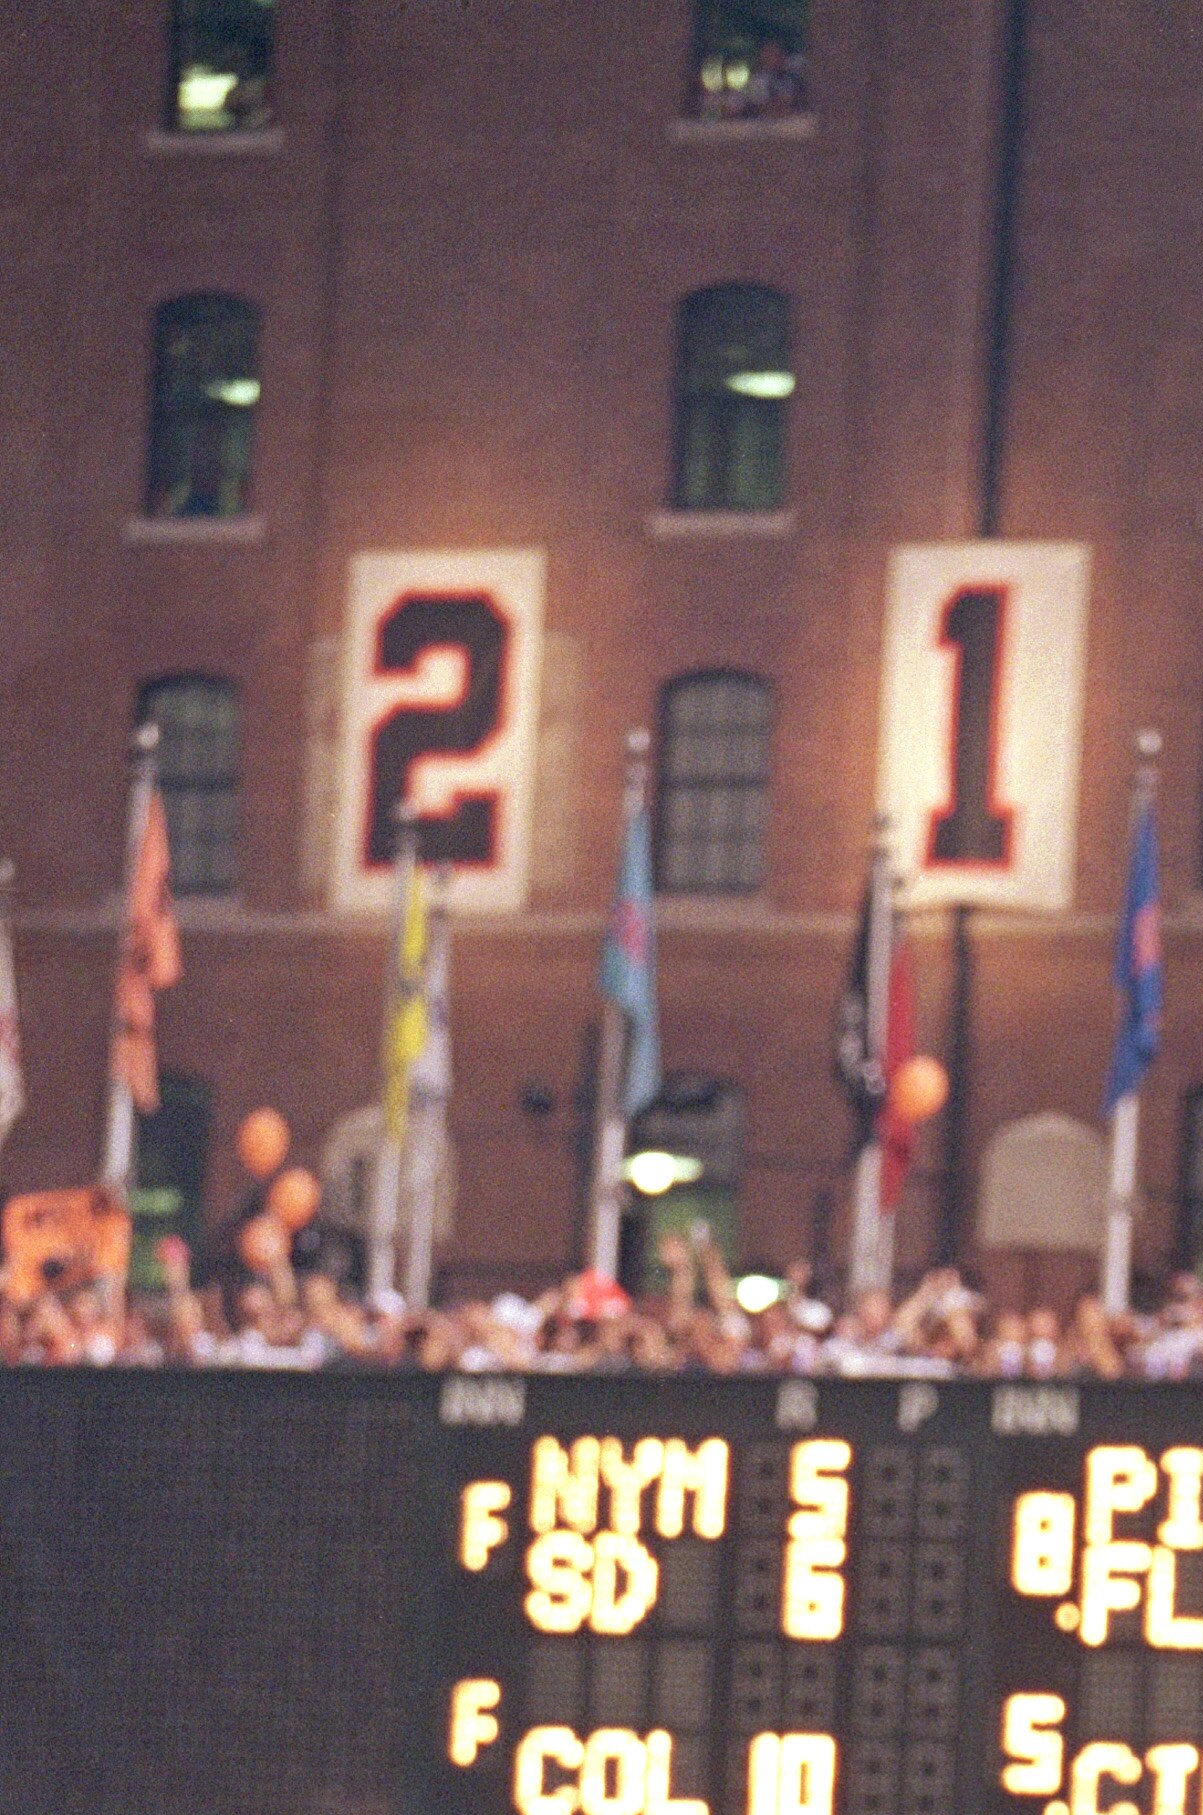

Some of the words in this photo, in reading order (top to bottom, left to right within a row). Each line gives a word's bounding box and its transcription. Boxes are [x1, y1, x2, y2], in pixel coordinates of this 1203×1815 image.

[363, 591, 511, 869] 2
[923, 581, 1013, 872] 1
[462, 1481, 511, 1571] F
[530, 1435, 729, 1540] NYM
[525, 1529, 659, 1634] SD
[783, 1536, 845, 1640] 6
[449, 1679, 501, 1766] F
